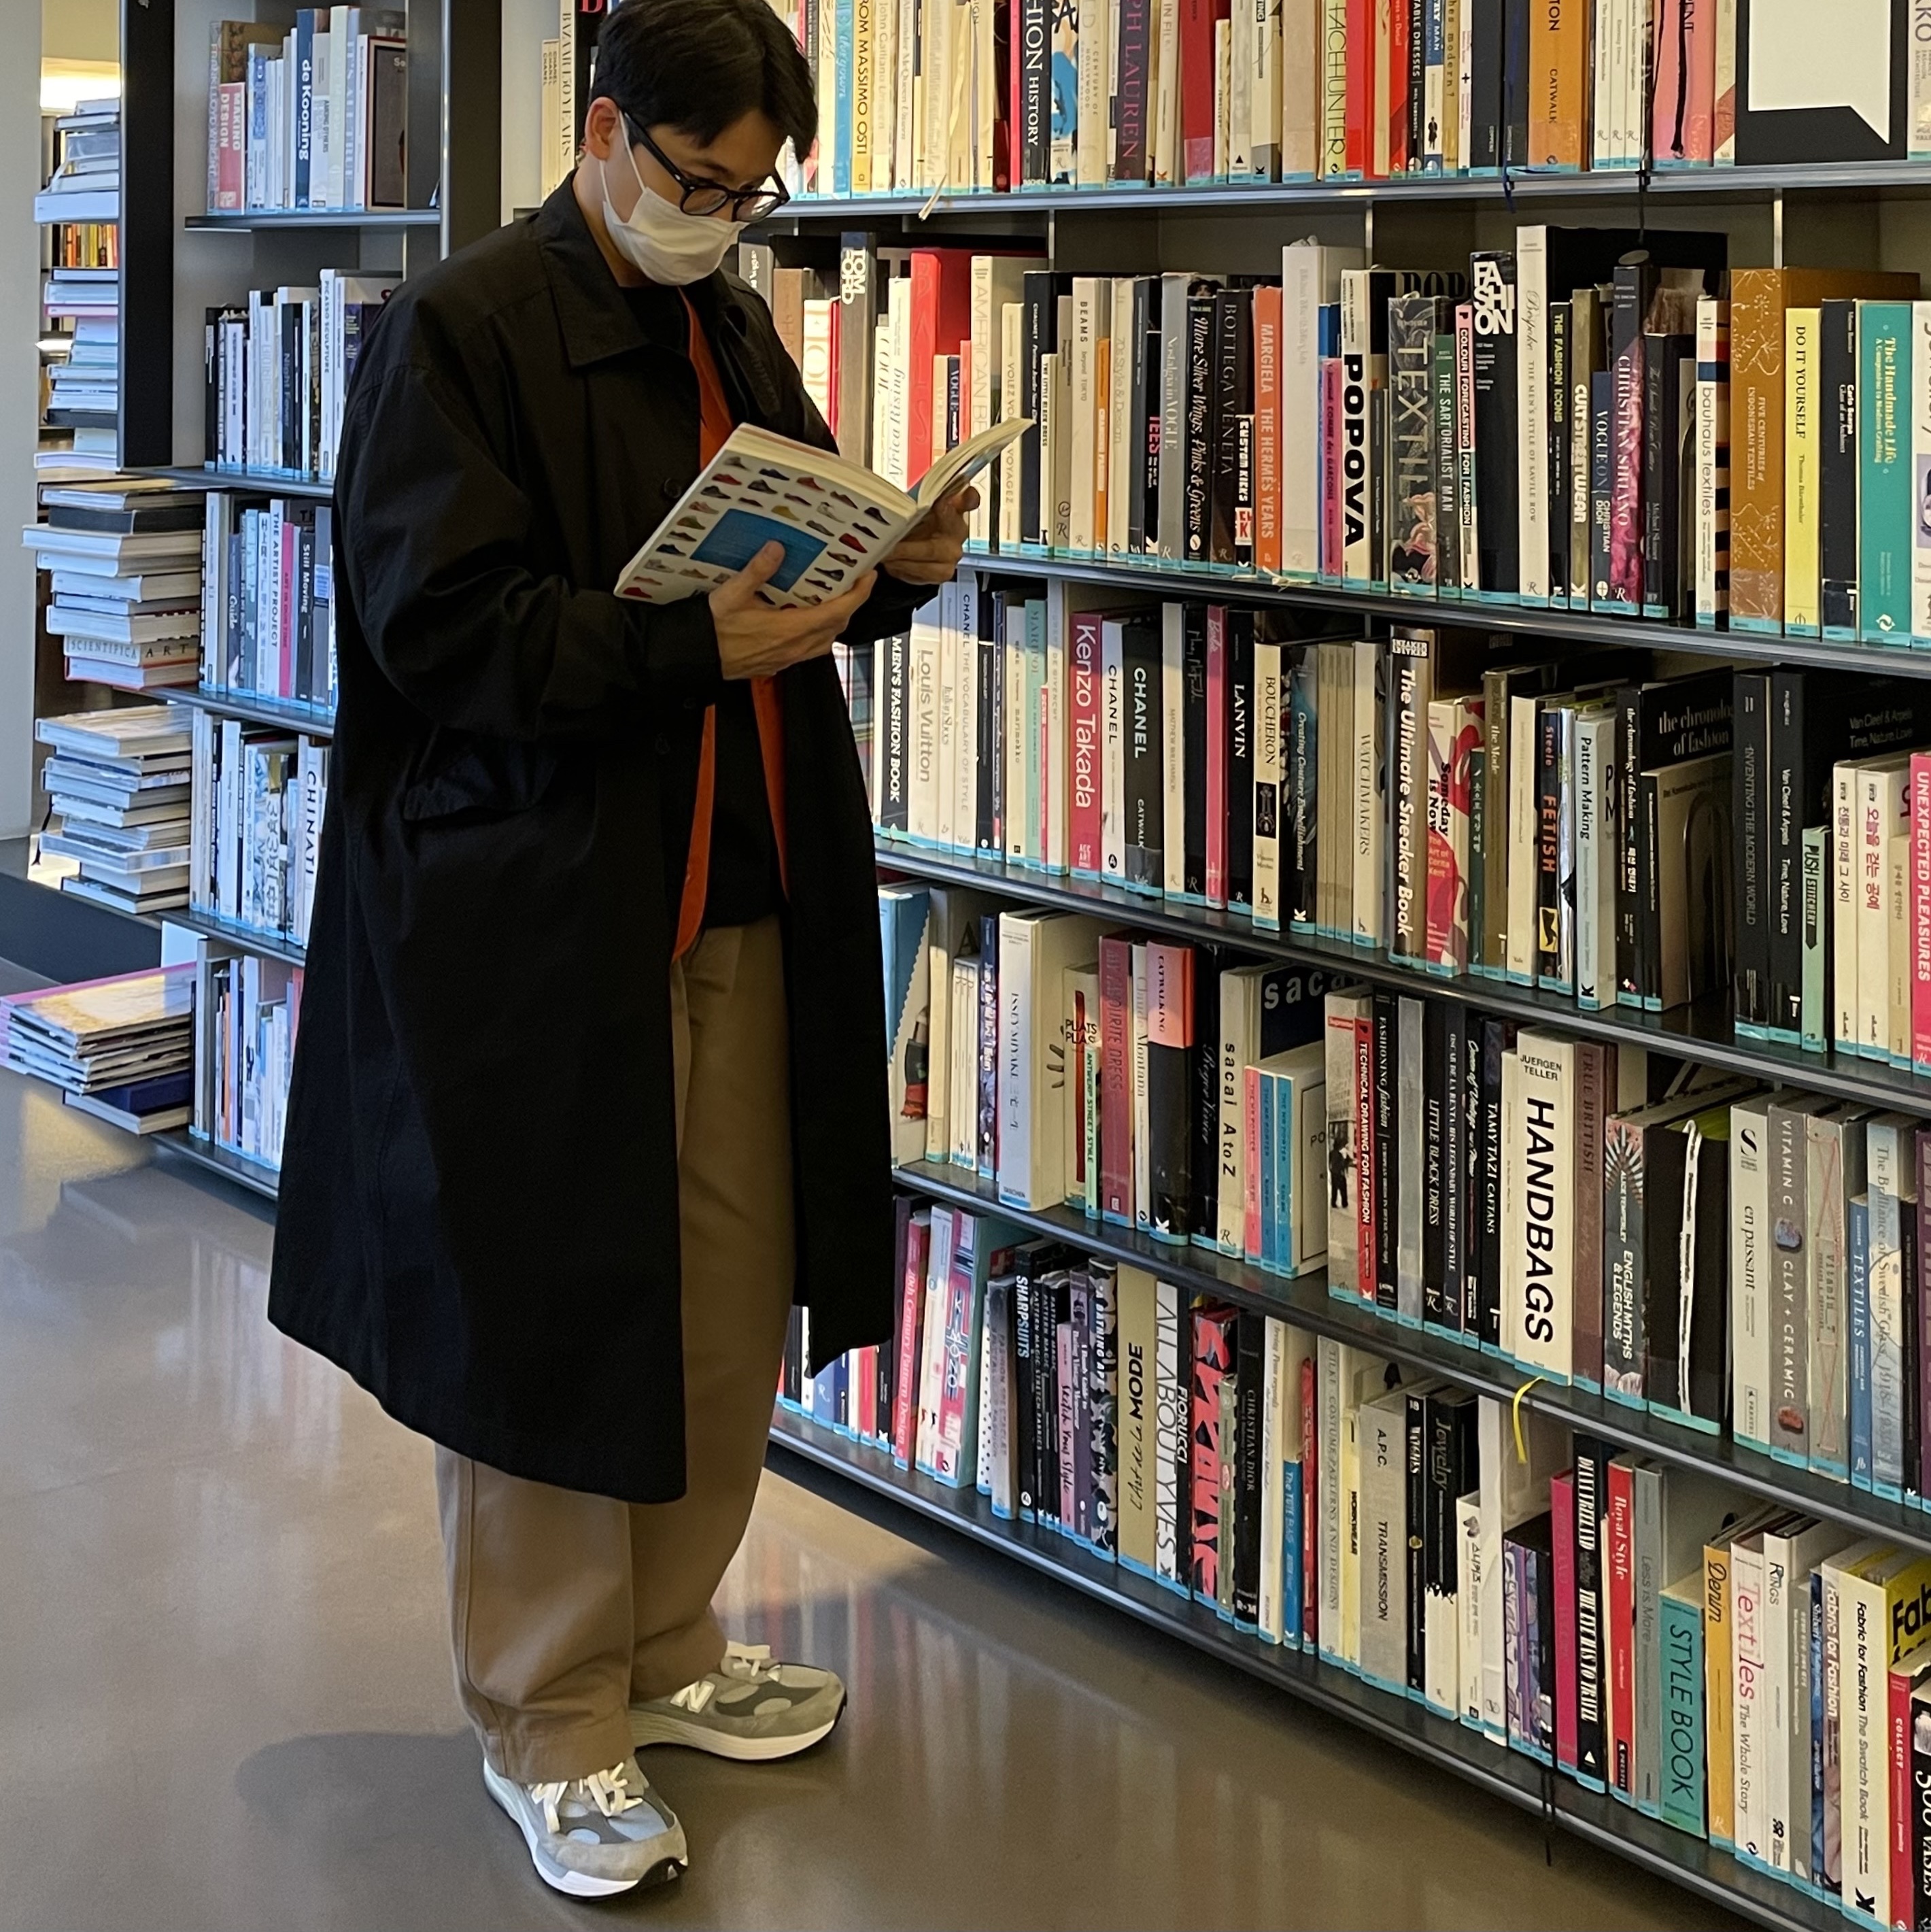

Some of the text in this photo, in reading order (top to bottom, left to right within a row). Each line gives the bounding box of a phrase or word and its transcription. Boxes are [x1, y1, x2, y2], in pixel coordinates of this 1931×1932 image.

[561, 12, 572, 66] BAZAAR
[857, 39, 868, 116] MASSIMO
[1327, 3, 1346, 155] FACEHUNTER
[220, 93, 229, 148] DESIGN
[232, 92, 241, 151] MAKING
[299, 59, 311, 160] de Kooning
[561, 97, 571, 156] YEARS
[1027, 77, 1039, 146] HISTORY
[1122, 44, 1142, 158] LAUREN
[1548, 69, 1558, 124] CATWALK
[857, 121, 868, 155] OSTI
[842, 250, 855, 305] FORD
[850, 250, 866, 294] TOM
[889, 368, 906, 426] Rising
[1795, 326, 1806, 439] DO IT YOURSELF
[1884, 337, 1896, 464] The Handmade Life
[1186, 317, 1208, 532] More Silver Wings, Pinks & Greens
[1238, 421, 1249, 502] CUSTOM KICKS
[1261, 324, 1276, 539] MARGIELA THE HERMÈS YEARS
[1344, 354, 1365, 548] POPOVA
[1439, 373, 1453, 512] THE SARTORIALIST MAN
[1460, 328, 1471, 526] COLOUR FORECASTING FOR FASHION
[1595, 411, 1609, 464] VOGUE
[1701, 387, 1715, 516] bauhaus textiles
[1595, 500, 1603, 524] DIOR
[1603, 500, 1611, 553] CHRISTIAN
[228, 595, 238, 629] Guide
[301, 543, 311, 613] Still Moving
[962, 594, 971, 647] CHANEL
[890, 637, 903, 803] MEN'S FASHION BOOK
[920, 649, 934, 782] Louis Vuitton
[1075, 624, 1097, 808] Kenzo Takada
[1108, 664, 1118, 745] CHANEL
[1234, 683, 1246, 758] LANVIN
[1265, 676, 1276, 766] BOUCHERON
[1133, 667, 1147, 849] CHANEL CATWALK
[1359, 734, 1371, 856] WATCHMAKERS
[1580, 736, 1592, 841] Pattern Making
[305, 770, 317, 876] CHINATI
[1397, 669, 1416, 937] The Ultimate Sneaker Book
[1429, 779, 1439, 835] is Now
[1439, 762, 1452, 837] Someday
[1543, 795, 1556, 872] FETISH
[1866, 806, 1879, 847] 오늘을
[1804, 844, 1820, 926] PUSH STITCHERY
[1839, 841, 1849, 862] 미래
[1839, 865, 1849, 877] 그
[1839, 880, 1850, 903] 사이
[1916, 771, 1930, 981] UNEXPECTED PLEASURES
[1866, 882, 1880, 910] 공예
[1520, 1054, 1562, 1072] JUERGEN
[1524, 1064, 1558, 1081] TELLER
[1223, 1043, 1237, 1178] sacai A to Z
[1360, 1043, 1371, 1224] TECHNICAL DRAWING FOR FASHION
[1428, 1099, 1440, 1227] LITTLE BLACK DRESS
[1781, 1119, 1794, 1206] VITAMIN C
[1524, 1097, 1555, 1344] HANDBAGS
[1741, 1206, 1758, 1291] en passant
[1622, 1249, 1634, 1360] ENGLISH MYTHS
[1781, 1260, 1794, 1304] CLAY
[1853, 1253, 1865, 1338] TEXTILES
[1128, 1342, 1144, 1421] MODE
[1782, 1323, 1796, 1400] CERAMIC
[1156, 1299, 1176, 1555] ALL ABOUT YVES
[1177, 1385, 1188, 1464] FIORUCCI
[1378, 1521, 1388, 1622] TRANSMISSION
[1612, 1495, 1628, 1581] Royal Style
[1707, 1560, 1728, 1624] Denim
[670, 1681, 717, 1714] N
[1669, 1624, 1695, 1801] STYLE BOOK
[1737, 1581, 1764, 1814] Textiles The Whole Story
[1856, 1601, 1870, 1821] Fabric for Fashion The Swatch Book
[1896, 1717, 1904, 1769] COLLECT
